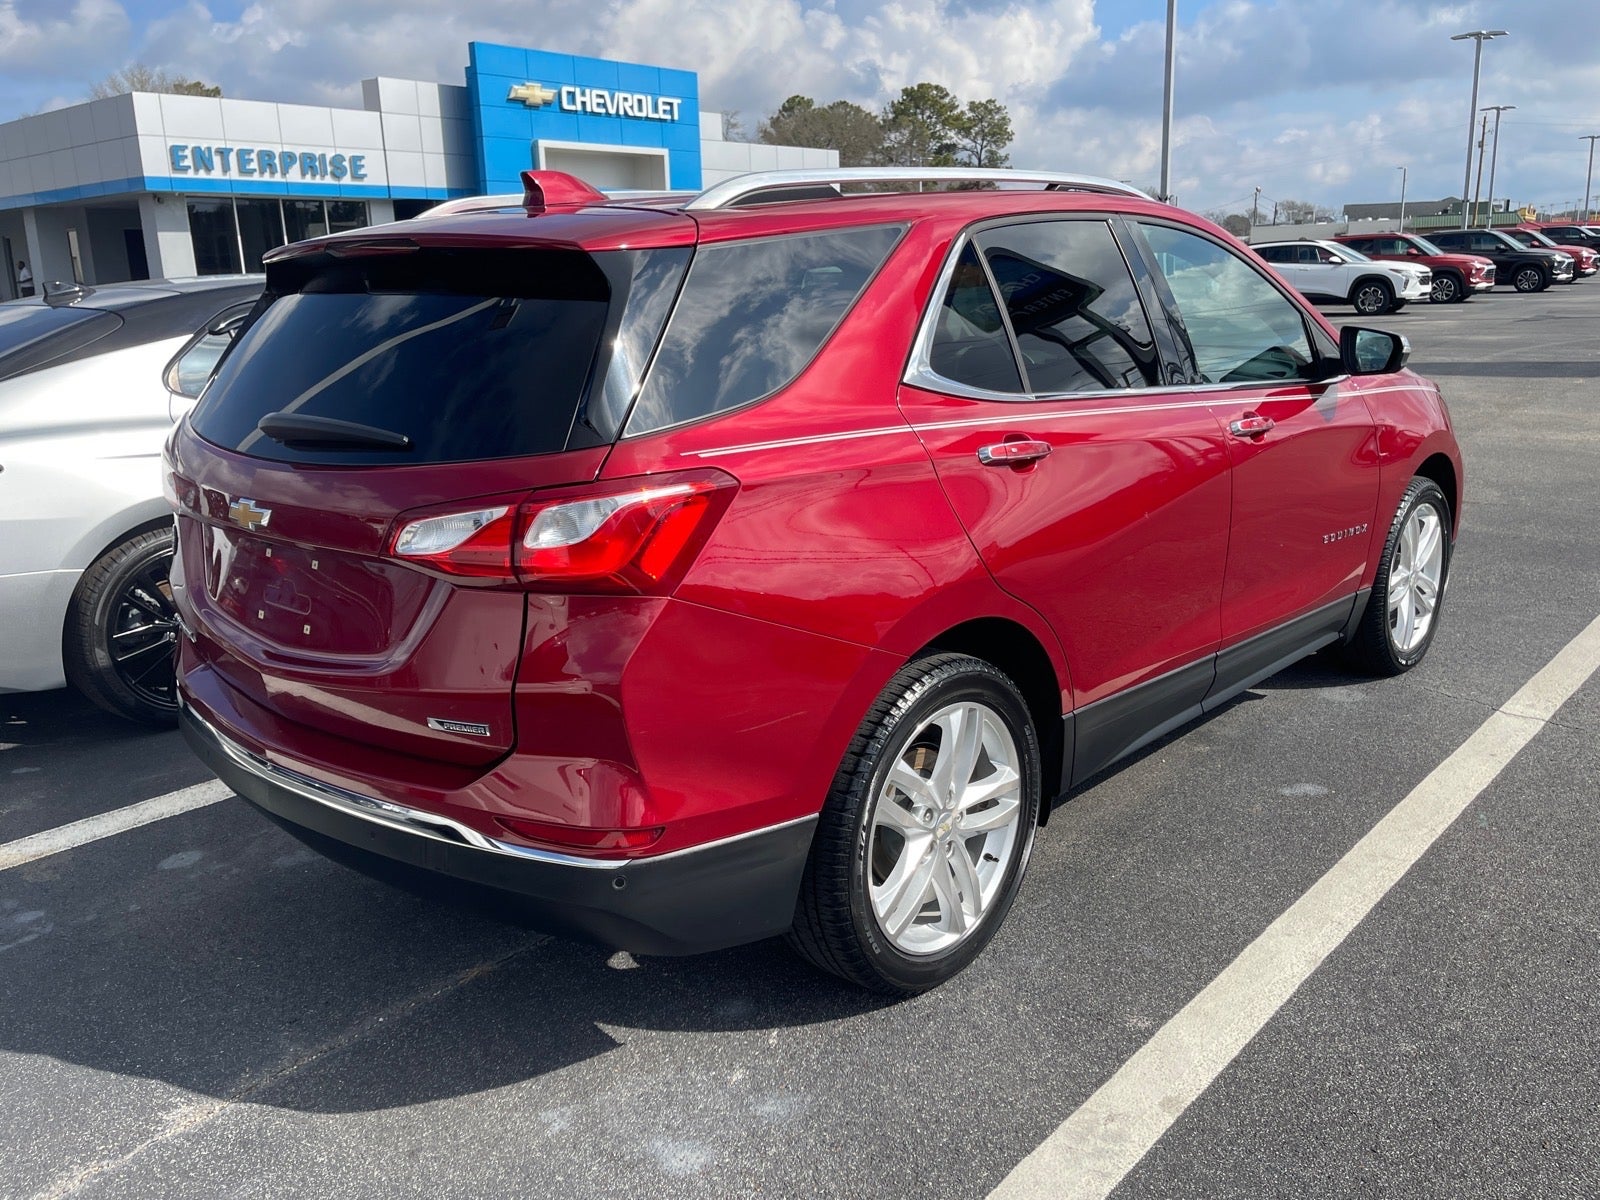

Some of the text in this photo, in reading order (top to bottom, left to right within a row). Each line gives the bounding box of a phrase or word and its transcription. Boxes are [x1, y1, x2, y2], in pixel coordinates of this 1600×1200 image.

[560, 86, 682, 121] CHEVROLET
[169, 144, 368, 180] ENTERPRISE
[1322, 522, 1368, 544] EQUINOX
[443, 722, 486, 734] PREMIER
